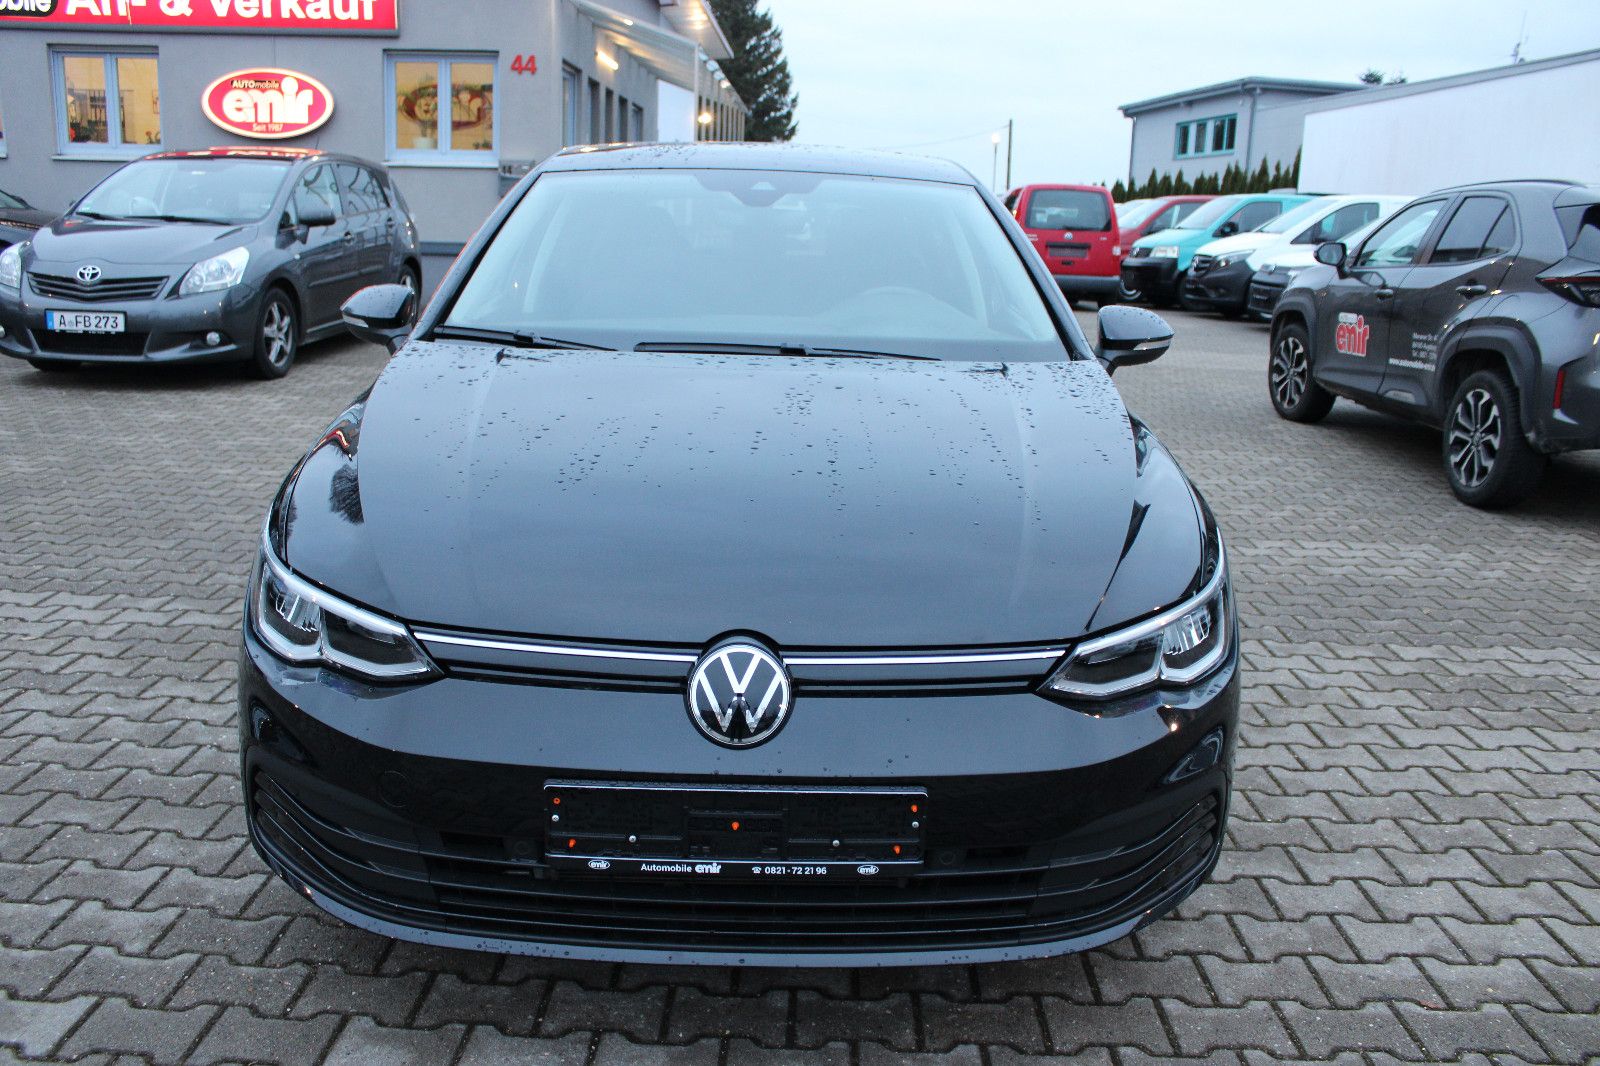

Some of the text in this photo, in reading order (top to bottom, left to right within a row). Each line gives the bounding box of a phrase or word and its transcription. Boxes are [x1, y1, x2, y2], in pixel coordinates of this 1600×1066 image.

[160, 0, 193, 17] &
[511, 54, 537, 75] 44
[222, 77, 313, 123] emir
[59, 315, 118, 328] A FB 273
[1336, 315, 1369, 357] emir
[640, 862, 721, 874] Automobile emir
[804, 866, 814, 875] 21
[816, 867, 827, 875] 96
